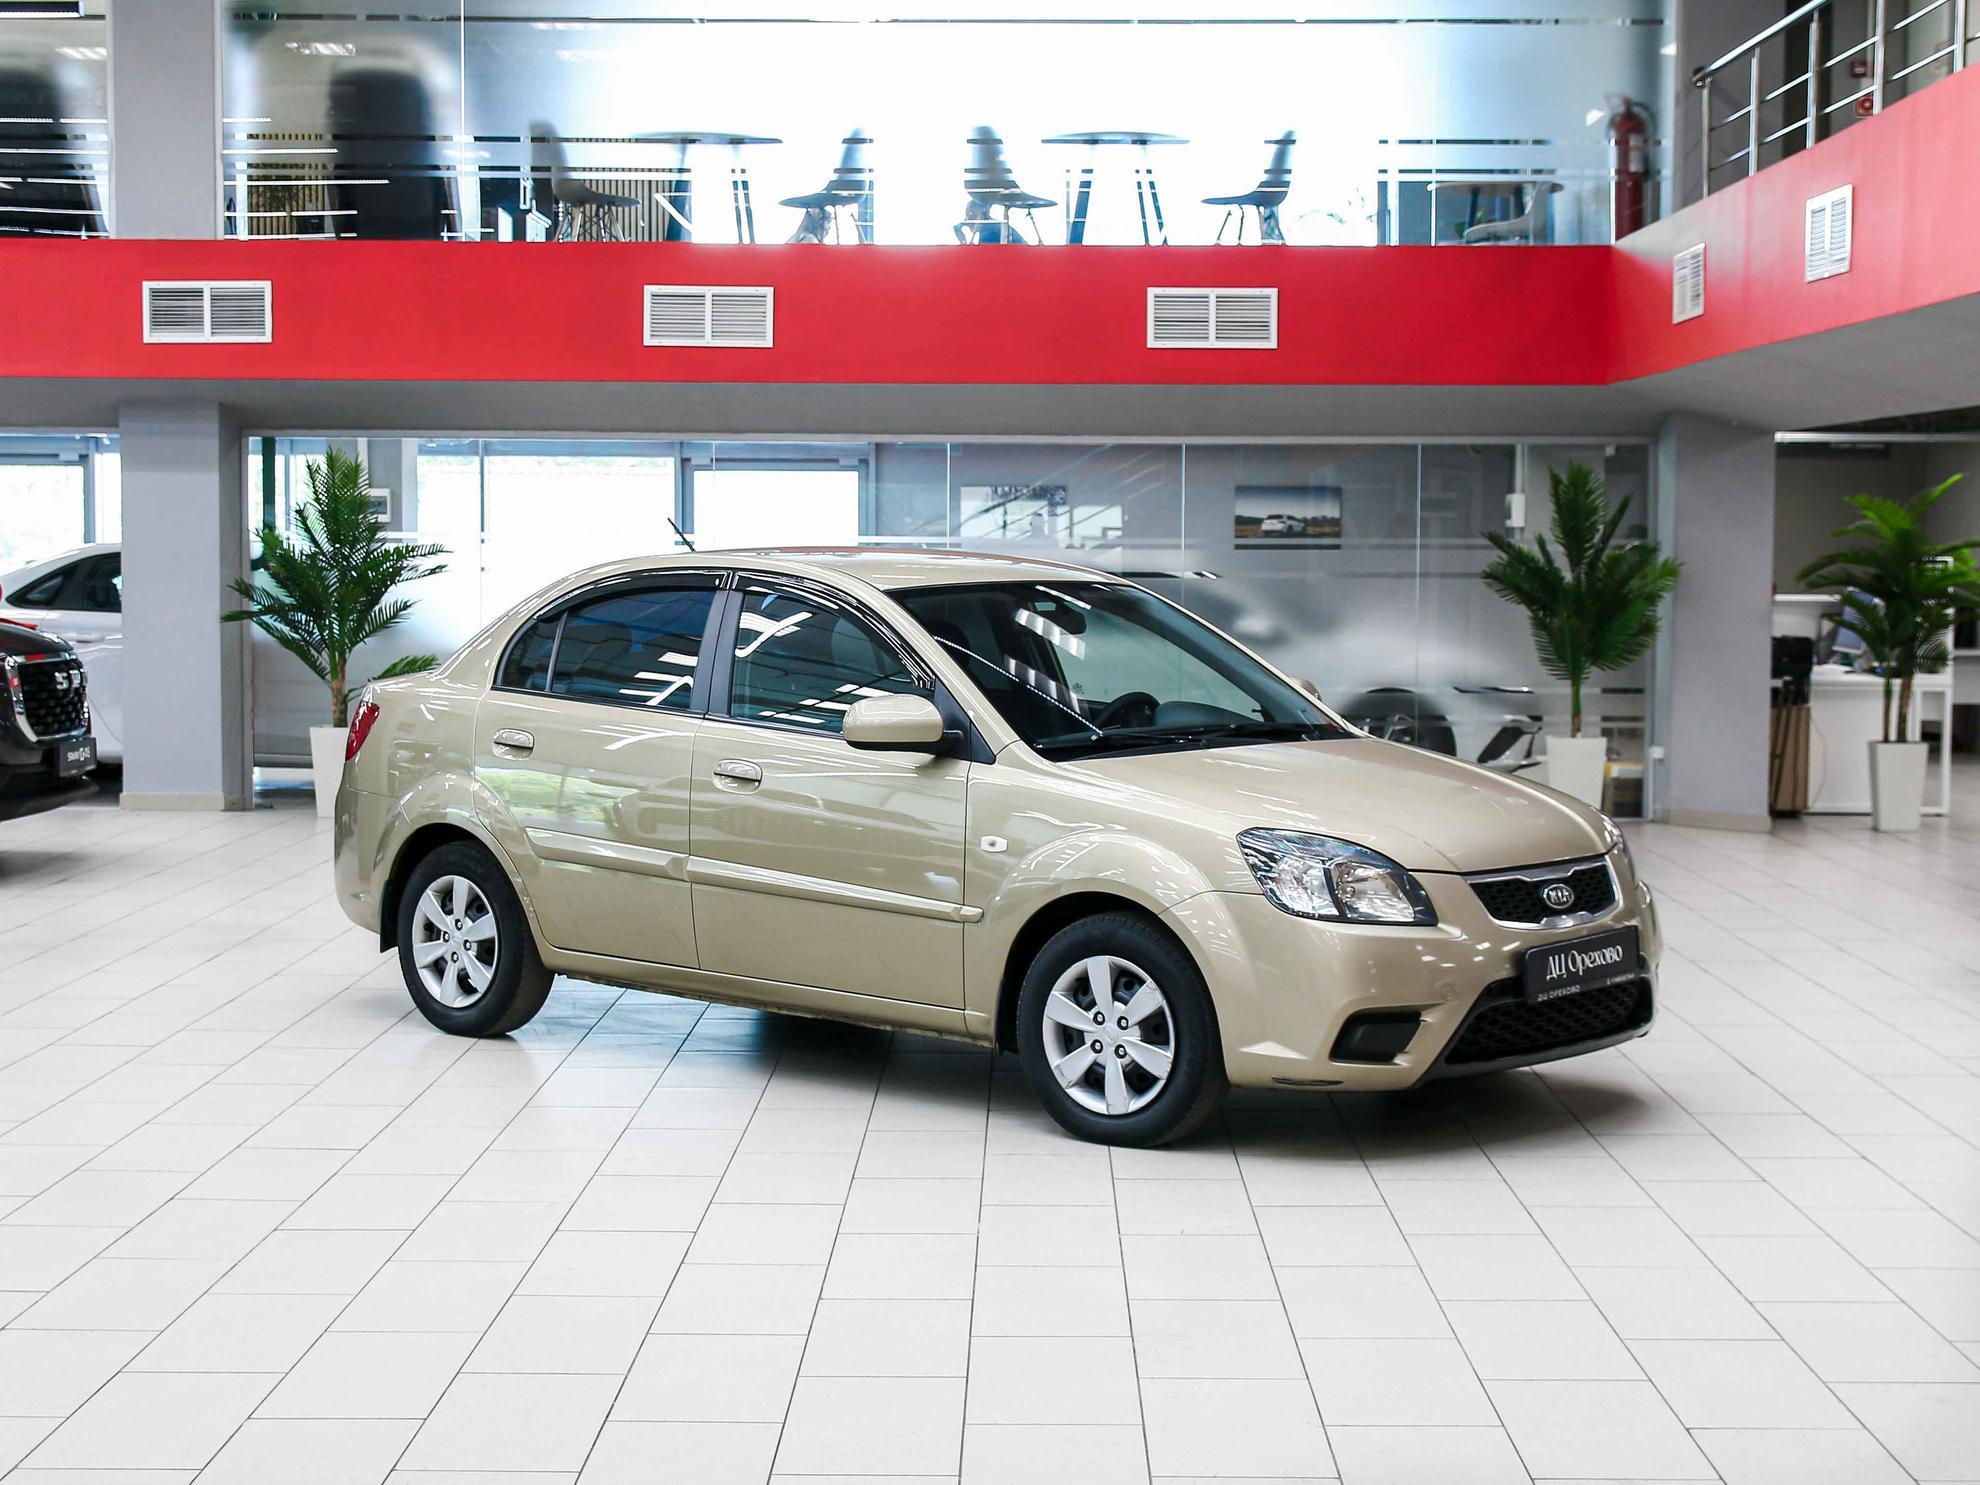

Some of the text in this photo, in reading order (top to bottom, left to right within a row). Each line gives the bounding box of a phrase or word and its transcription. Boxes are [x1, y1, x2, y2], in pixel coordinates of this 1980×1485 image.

[1549, 888, 1570, 902] KIA
[1545, 945, 1623, 981] ДЦ Орехово
